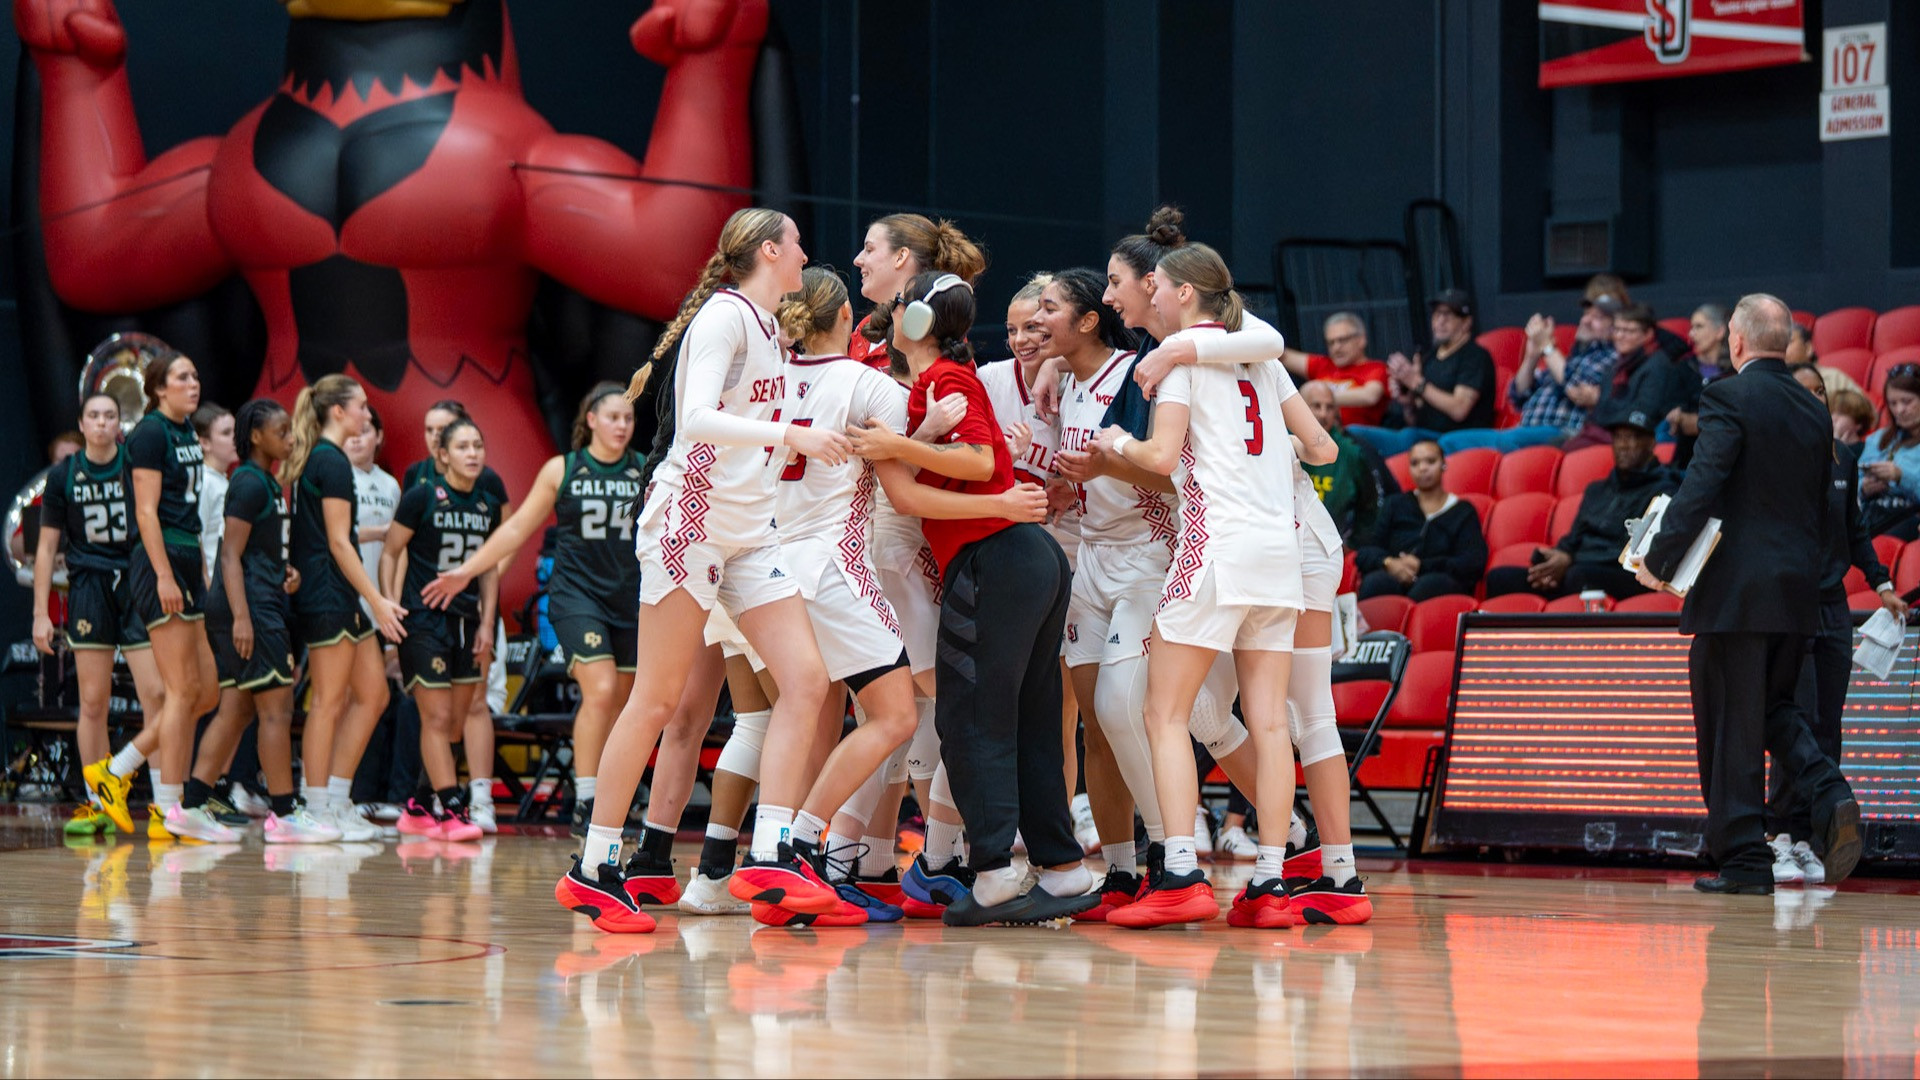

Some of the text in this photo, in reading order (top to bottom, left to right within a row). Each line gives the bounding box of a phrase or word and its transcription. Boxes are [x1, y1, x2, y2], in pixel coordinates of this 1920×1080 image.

[1833, 43, 1876, 86] 107
[1831, 93, 1877, 112] GENERAL
[1825, 113, 1884, 134] ADMISSION
[1237, 379, 1264, 456] 3
[73, 481, 125, 503] CAL PO
[570, 480, 605, 497] CAL
[83, 501, 128, 544] 23
[433, 511, 491, 532] CAL POLY
[580, 499, 635, 541] 24
[1338, 640, 1398, 664] EATTLE
